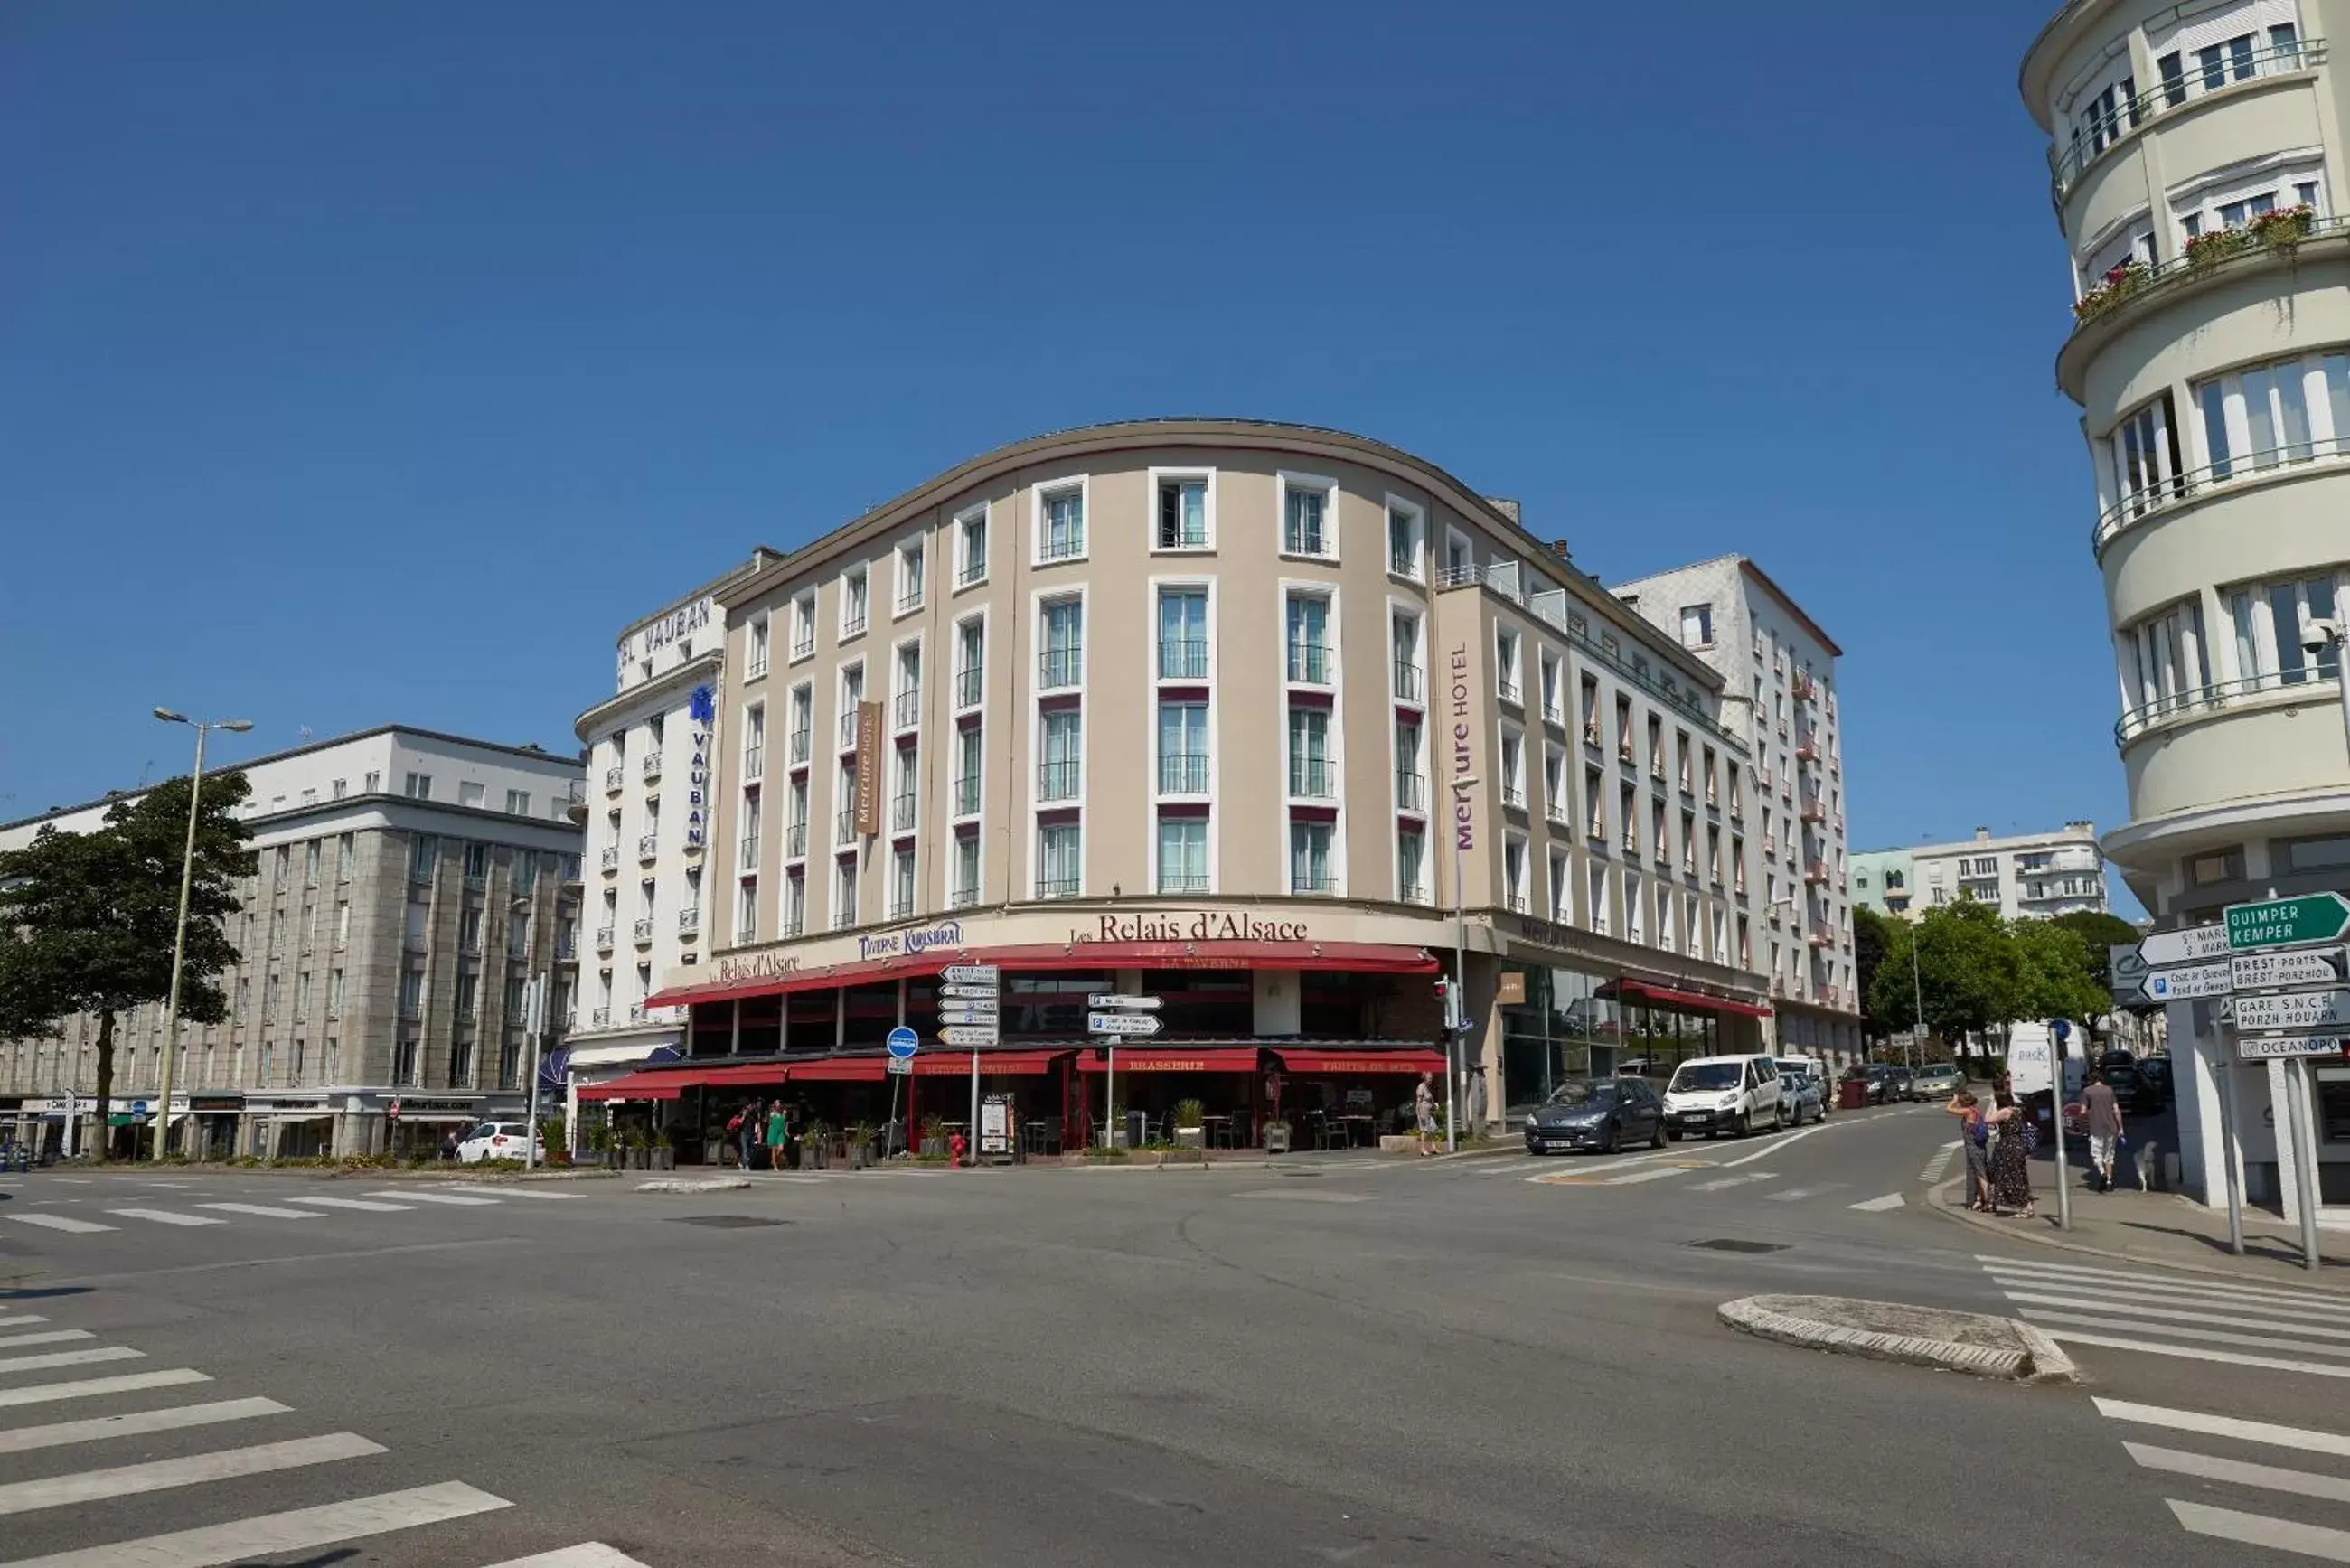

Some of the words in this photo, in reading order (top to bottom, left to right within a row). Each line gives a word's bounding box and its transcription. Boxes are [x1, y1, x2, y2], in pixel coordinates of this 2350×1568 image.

[645, 600, 710, 651] VAUBAN
[1452, 642, 1468, 717] HOTEL
[689, 732, 705, 843] VAUBAN
[859, 756, 871, 822] Mercure
[1100, 914, 1180, 941] Relais
[1190, 912, 1308, 941] d'Alsace
[2231, 906, 2298, 926] QUIMPER
[2233, 924, 2293, 943] KEMPER
[720, 959, 751, 982] Relais
[2240, 1000, 2274, 1013] GARE
[1129, 1061, 1204, 1071] BRASSERIE
